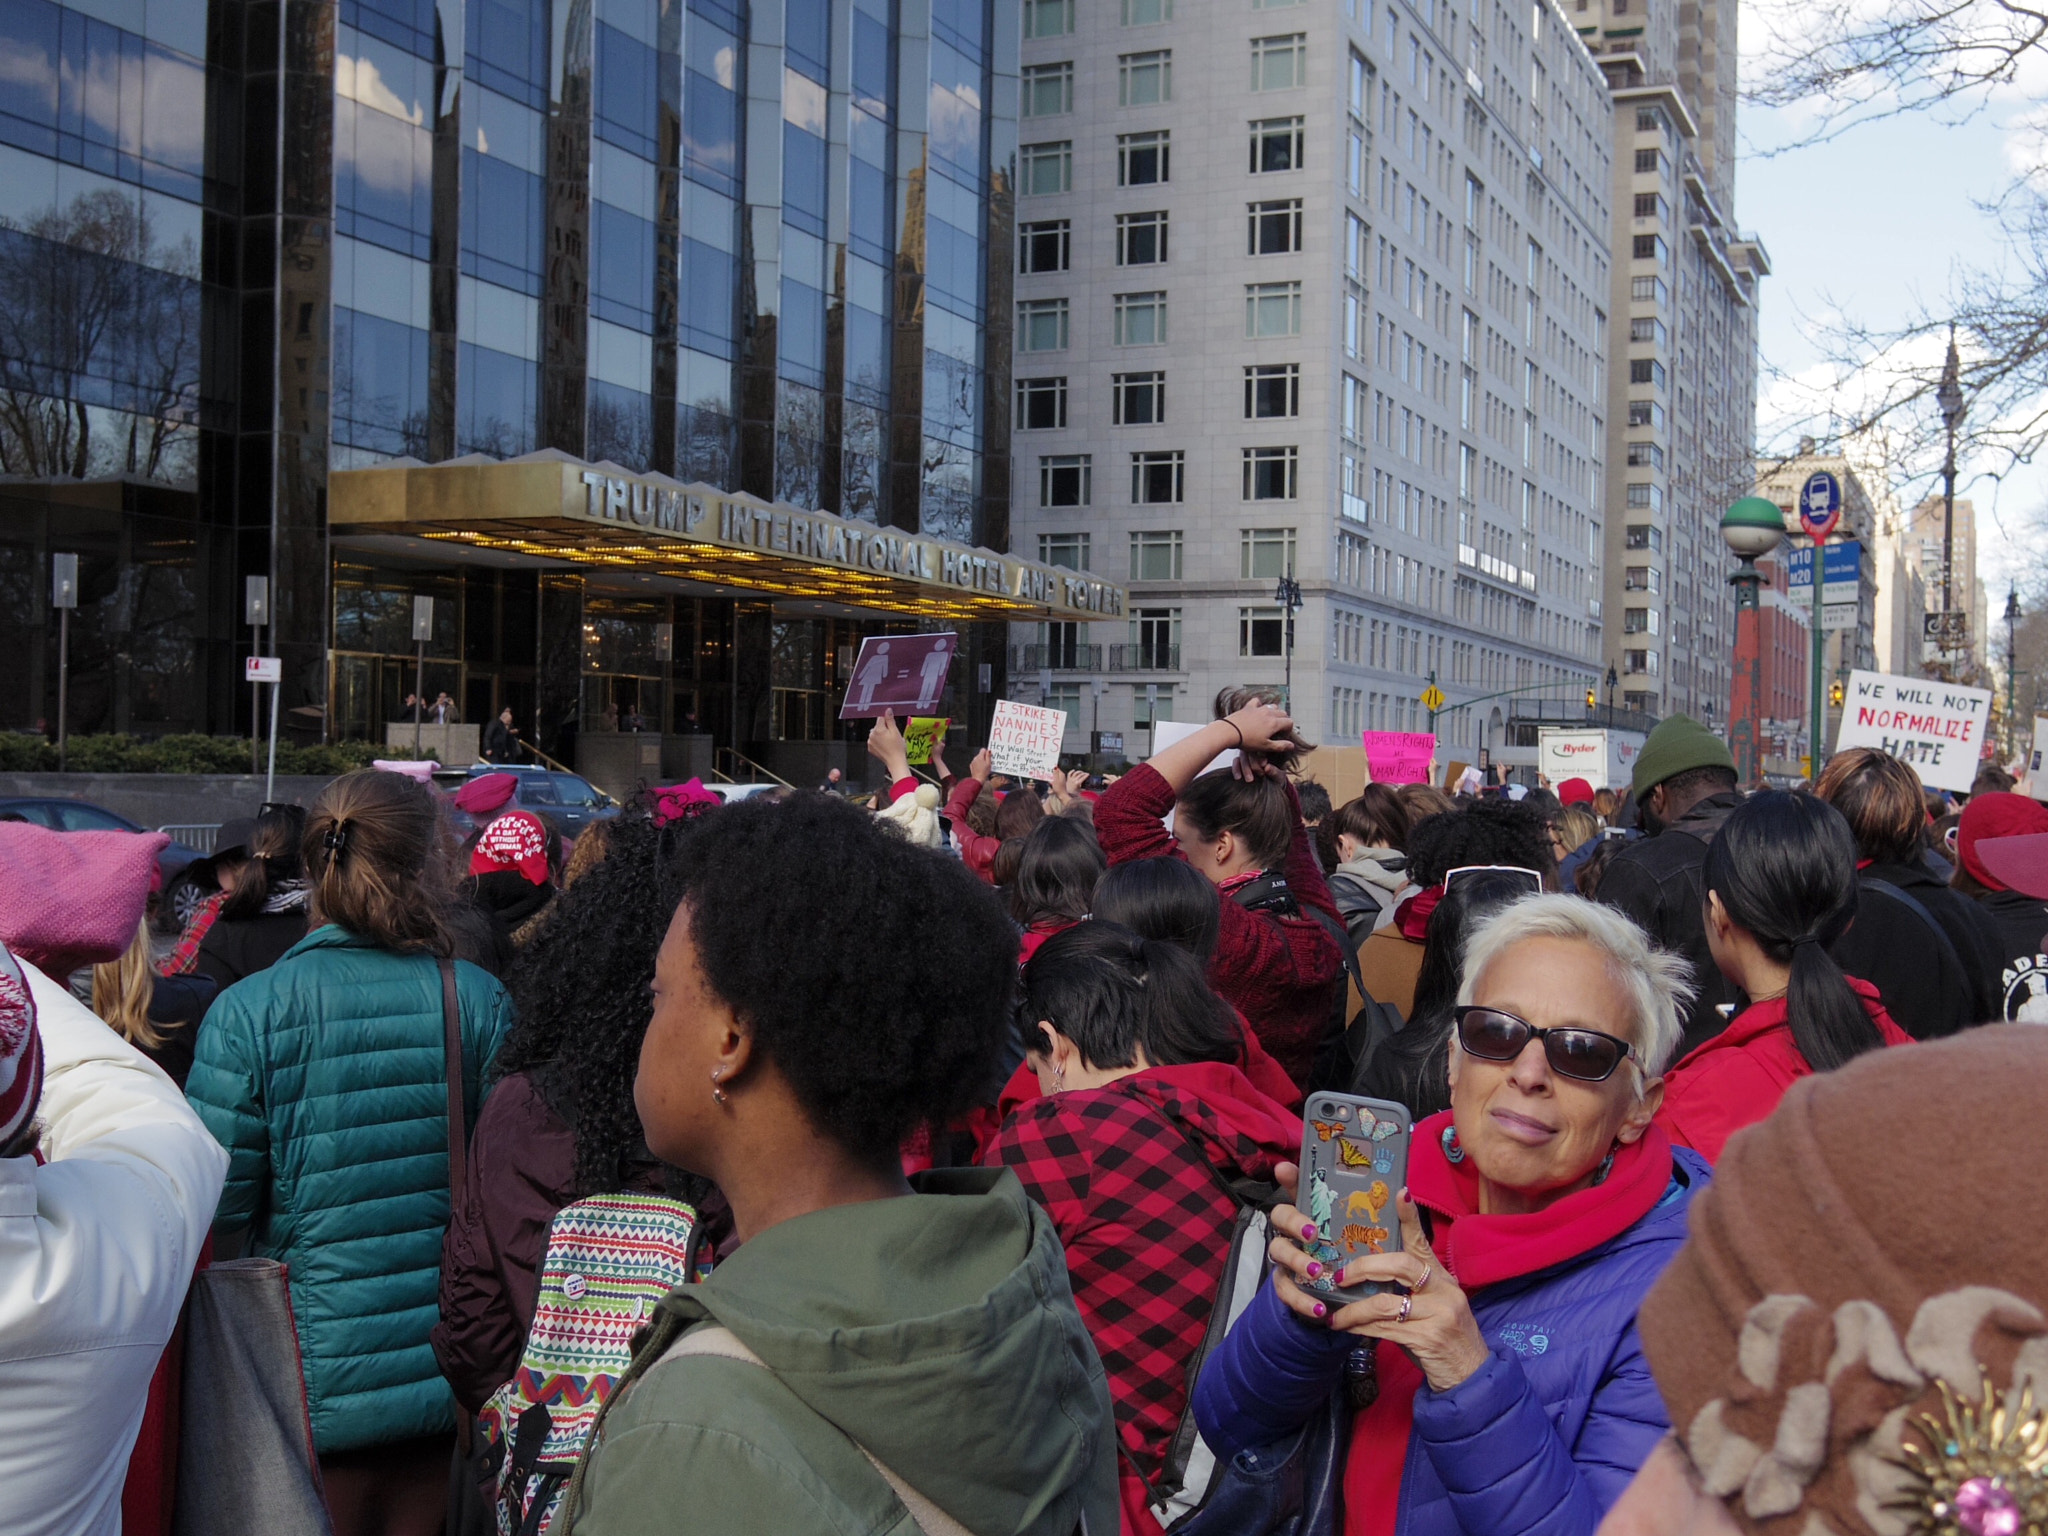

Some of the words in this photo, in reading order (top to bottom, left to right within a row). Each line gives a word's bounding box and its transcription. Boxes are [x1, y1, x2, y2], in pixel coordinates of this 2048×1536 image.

[582, 471, 702, 533] TRUMP
[719, 501, 933, 579] INTERNATIONAL
[940, 549, 1010, 594] HOTEL
[1013, 567, 1056, 602] AND
[1062, 578, 1123, 617] TOWER
[1790, 549, 1811, 565] M10
[1790, 569, 1811, 584] M20
[1858, 682, 1884, 698] WE
[1896, 688, 1933, 705] WILL
[1943, 694, 1982, 713] NOT
[998, 702, 1006, 713] I
[1012, 704, 1047, 720] STRIKE
[1053, 711, 1059, 724] 4
[994, 716, 1058, 737] NANNIES
[1858, 707, 1973, 742] NORMALIZE
[990, 741, 1004, 752] Hey
[1008, 745, 1024, 754] Wall
[993, 728, 1060, 753] RIGHTS
[1563, 743, 1597, 754] Ryder
[1881, 736, 1944, 765] HATE
[991, 761, 1008, 769] anny
